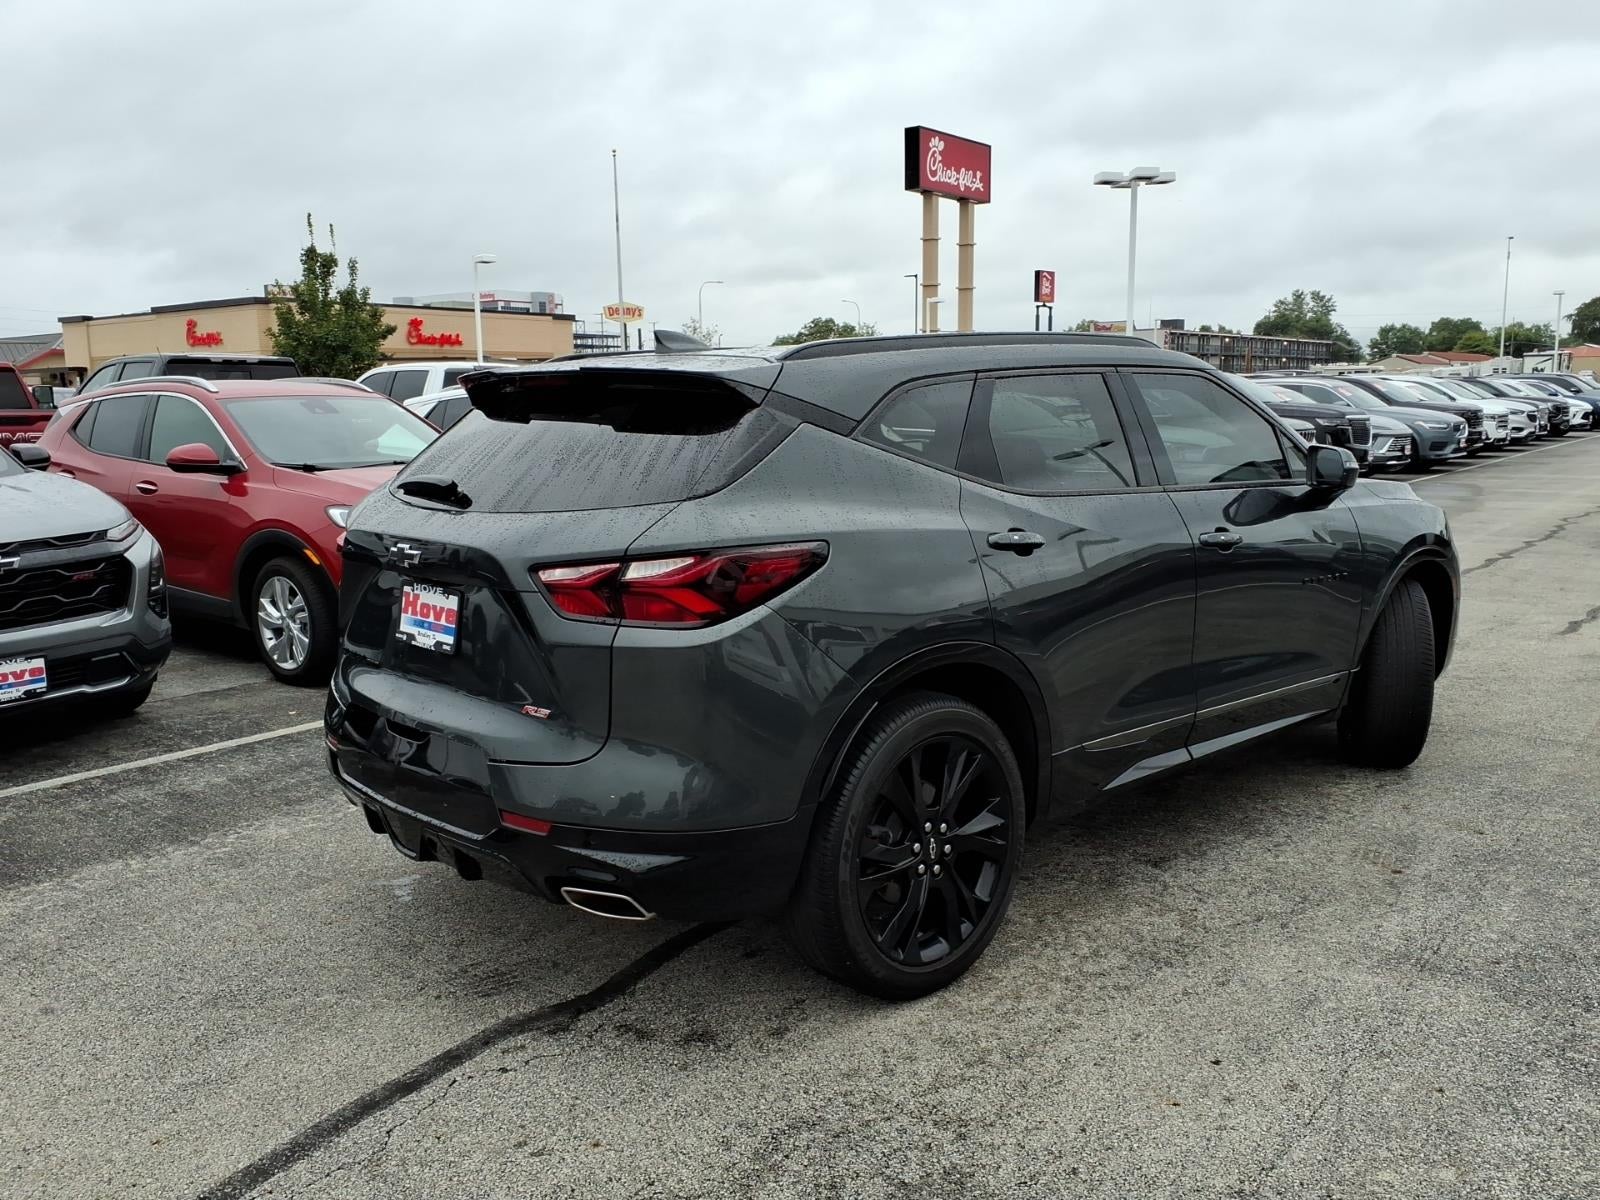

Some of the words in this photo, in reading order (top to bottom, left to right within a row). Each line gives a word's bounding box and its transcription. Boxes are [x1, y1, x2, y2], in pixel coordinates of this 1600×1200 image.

[927, 136, 984, 192] Chick-fil-A
[0, 432, 44, 443] MC
[402, 591, 457, 625] Hove
[0, 667, 45, 683] ove
